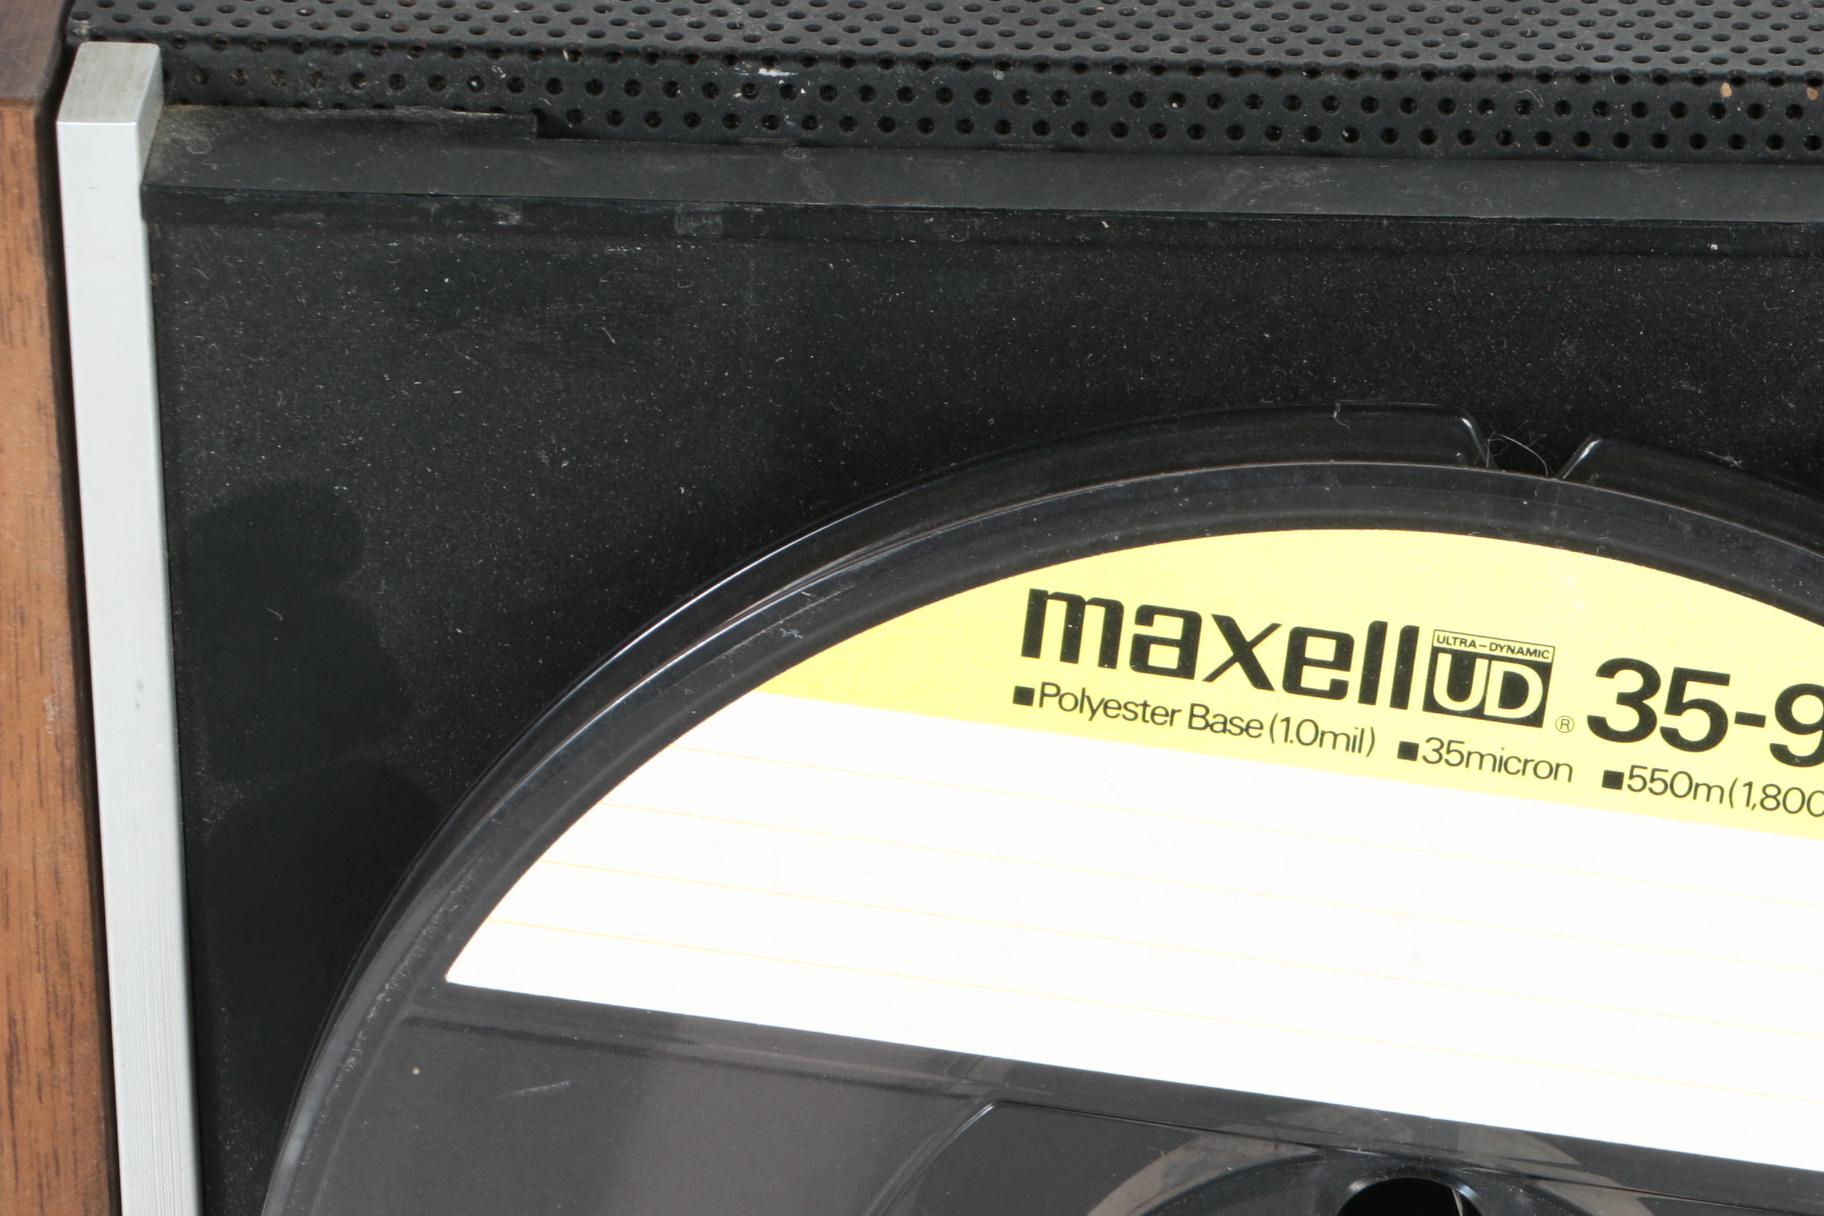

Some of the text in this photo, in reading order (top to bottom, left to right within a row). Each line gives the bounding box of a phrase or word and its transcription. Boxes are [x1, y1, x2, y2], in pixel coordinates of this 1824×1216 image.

[1020, 588, 1420, 711] maxell
[1432, 652, 1544, 720] UD
[1038, 681, 1182, 728] Polyester
[1422, 736, 1573, 783] 35micron
